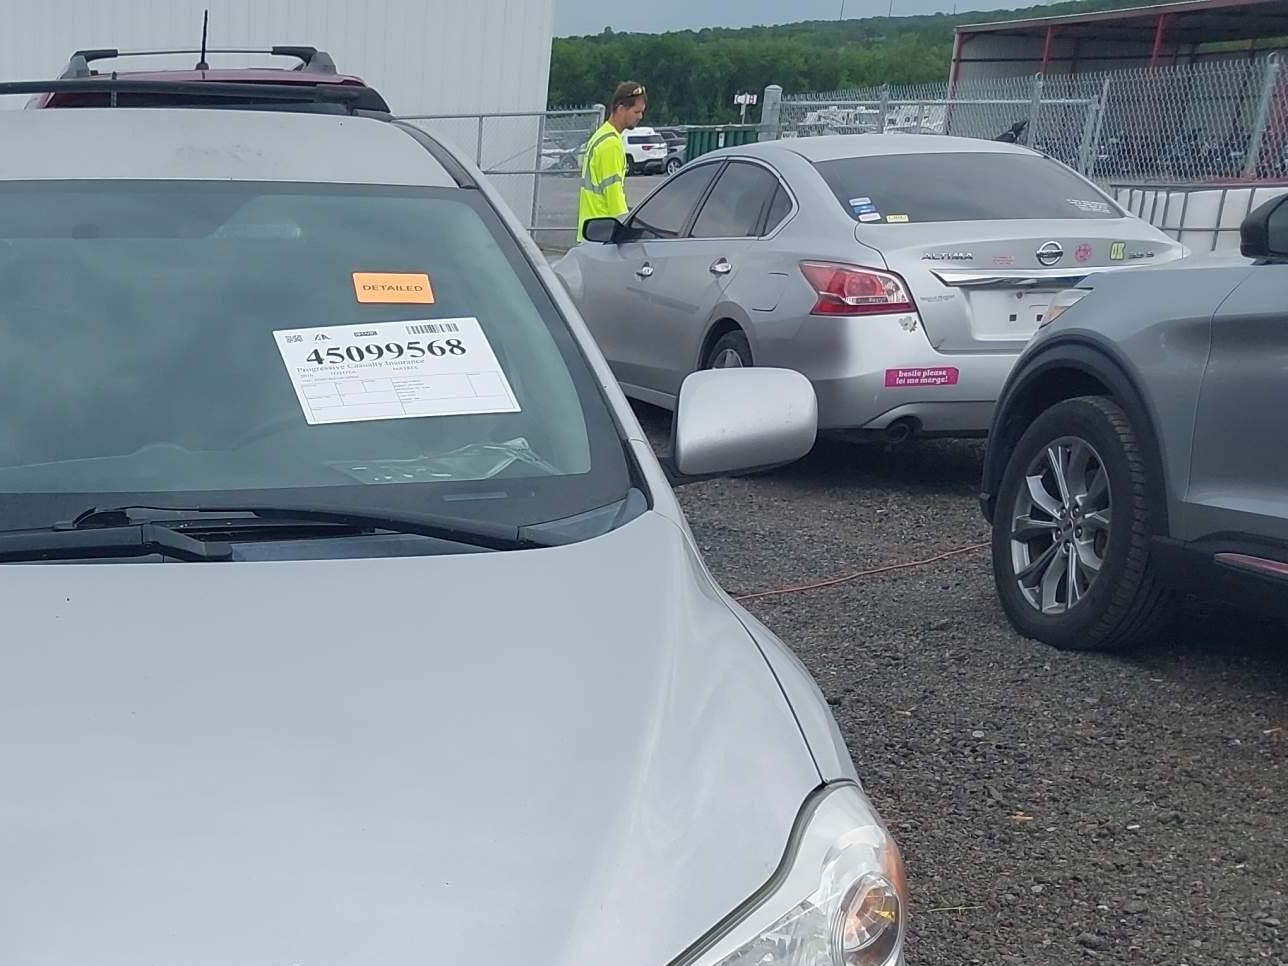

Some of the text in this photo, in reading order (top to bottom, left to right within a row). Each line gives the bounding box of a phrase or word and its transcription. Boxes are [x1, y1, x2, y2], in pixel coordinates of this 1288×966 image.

[921, 252, 973, 260] ALTIMA
[362, 284, 423, 292] DETAILED
[306, 338, 467, 365] 45099568
[297, 365, 345, 374] Progressive
[385, 358, 425, 366] Insurance
[922, 369, 947, 378] please
[920, 376, 948, 385] merge!
